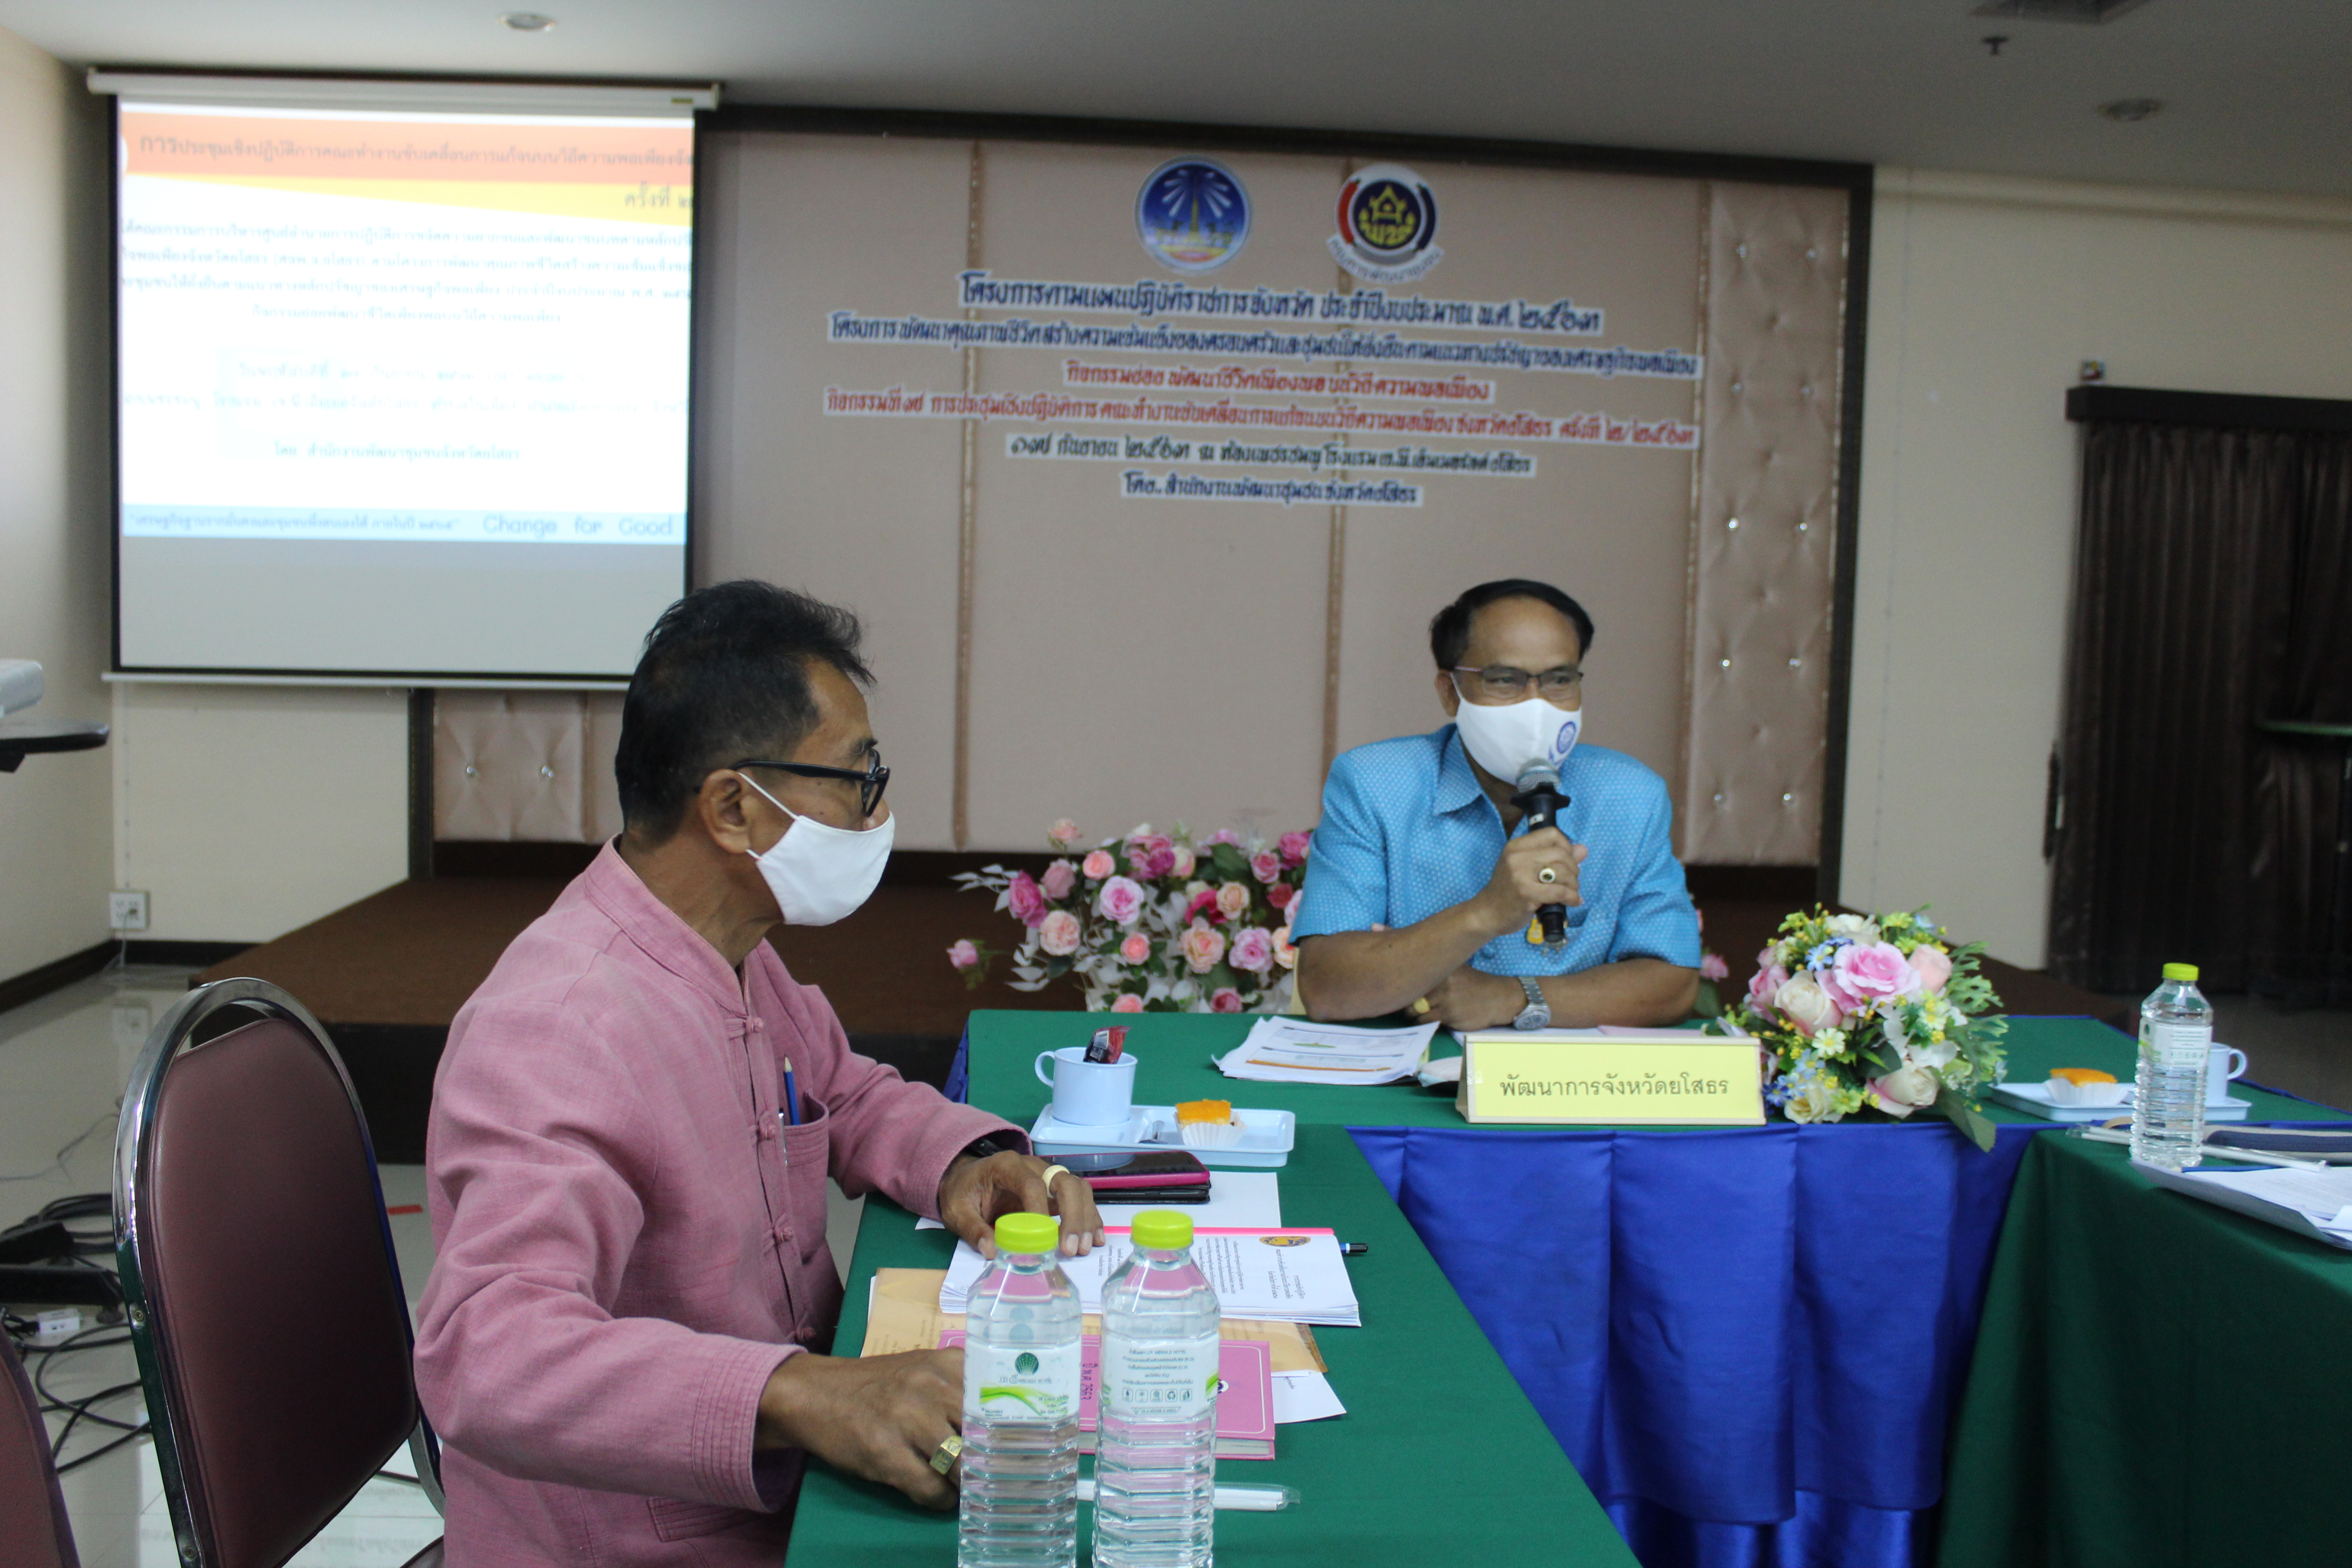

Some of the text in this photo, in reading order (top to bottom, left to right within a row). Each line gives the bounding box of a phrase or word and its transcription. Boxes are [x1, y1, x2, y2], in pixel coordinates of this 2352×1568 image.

[624, 180, 669, 208] ครั้งที่
[483, 514, 672, 539] Change for Good
[1500, 1073, 1729, 1097] พัฒนาการจังหวัดยโสธร
[1080, 1384, 1093, 1400] 2563
